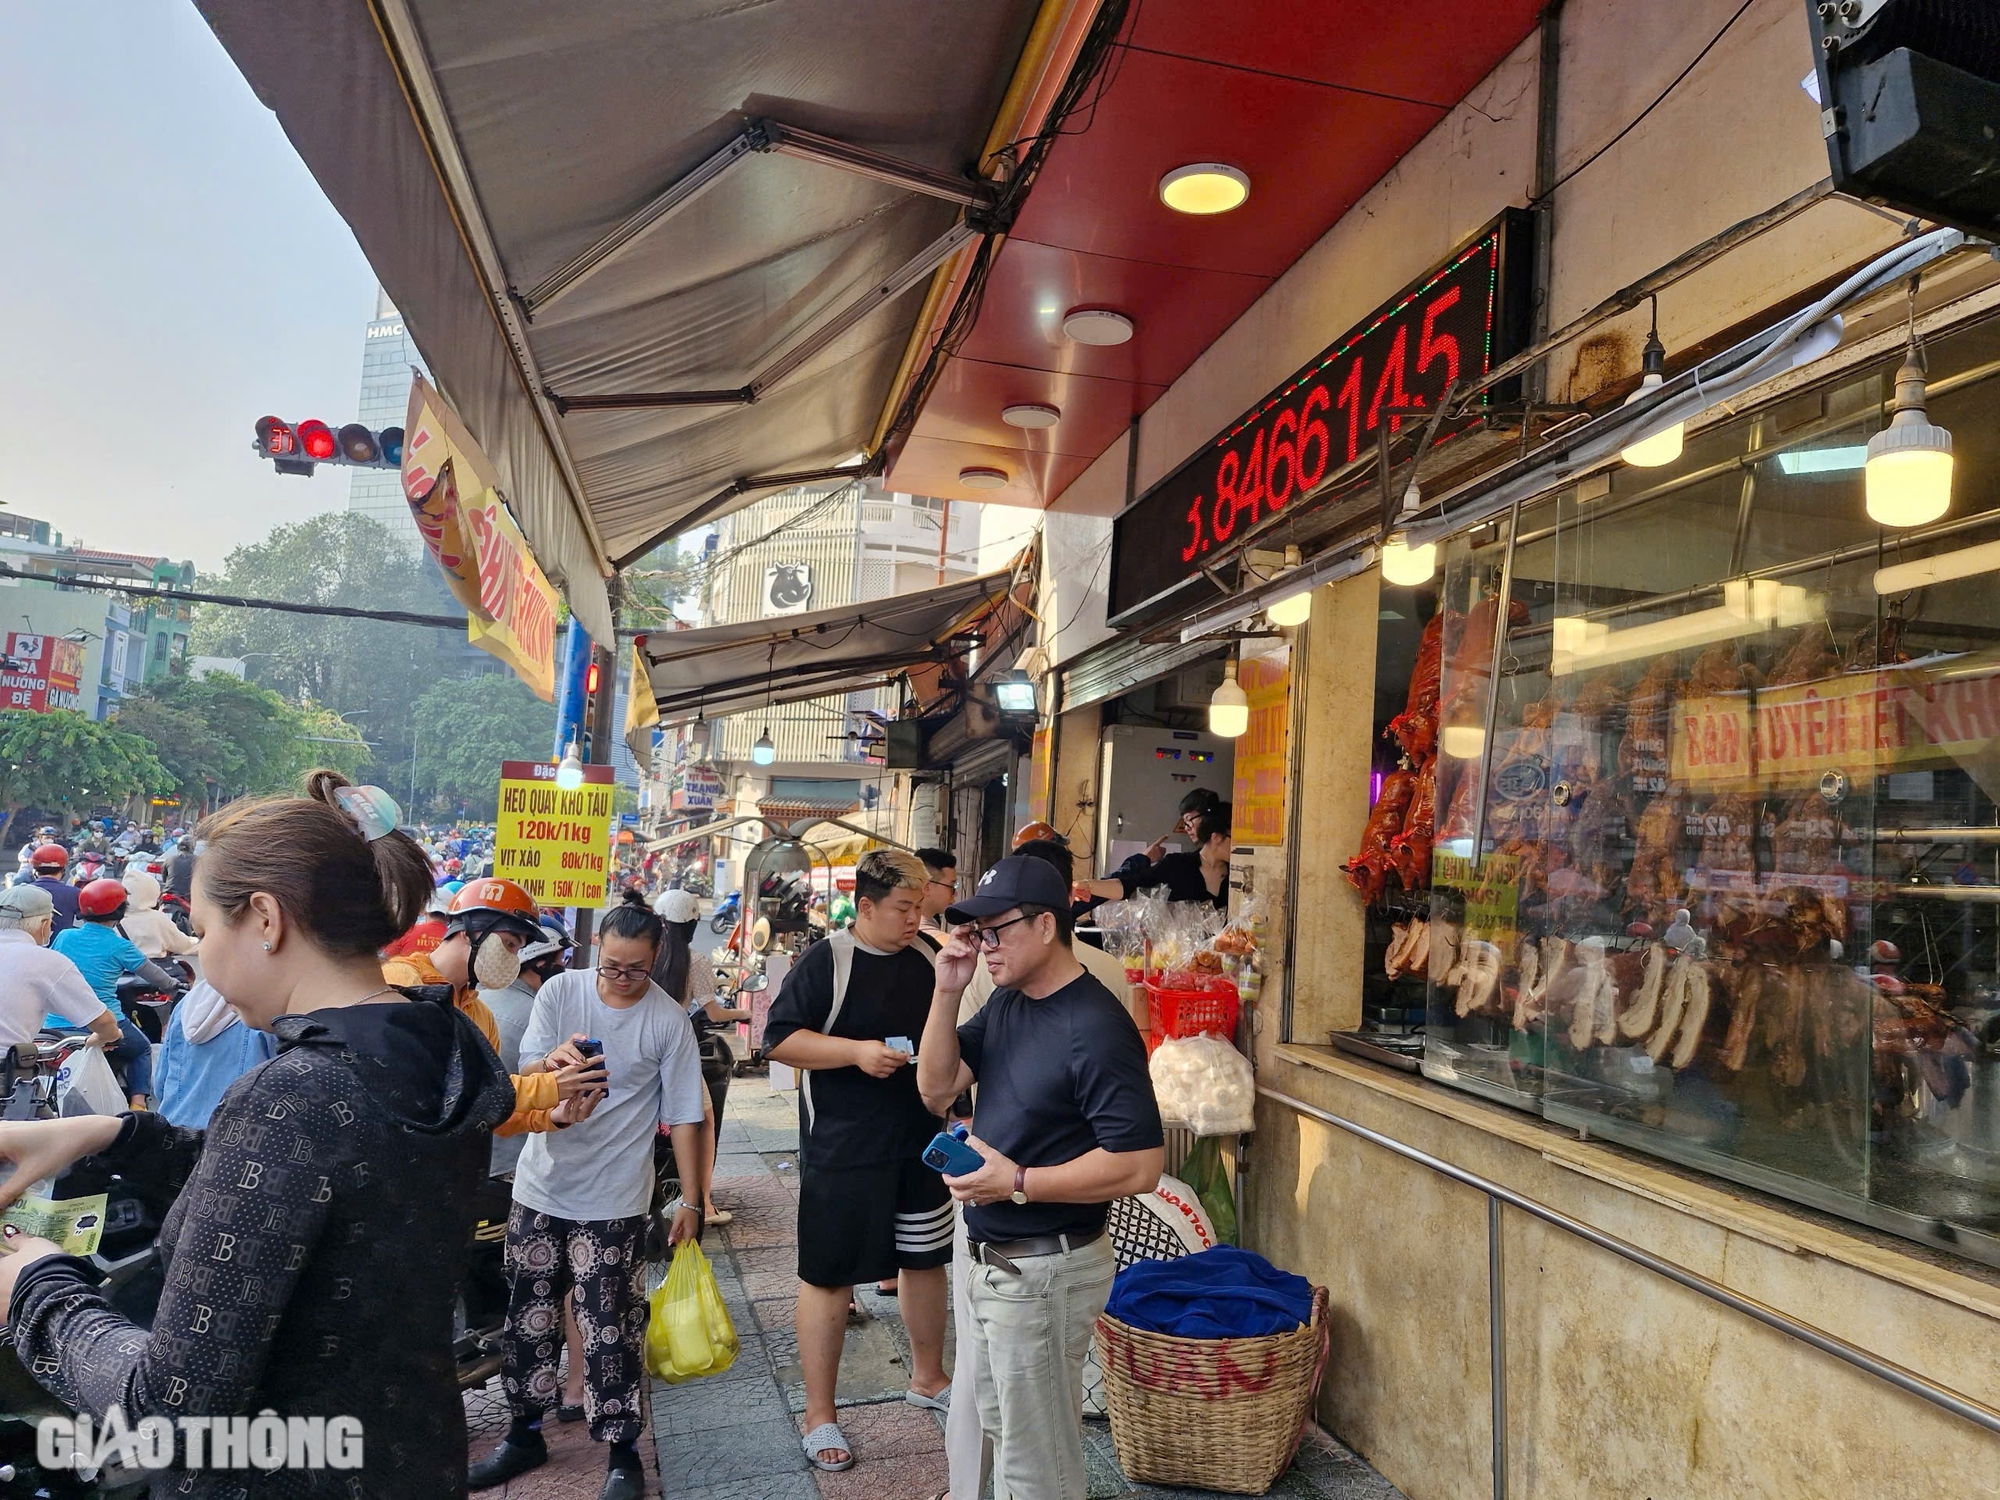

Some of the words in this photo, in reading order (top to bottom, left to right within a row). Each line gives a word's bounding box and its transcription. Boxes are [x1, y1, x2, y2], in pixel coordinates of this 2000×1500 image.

[504, 788, 526, 813] HEO
[530, 790, 558, 817] QUAY
[561, 792, 584, 817] KHO
[588, 788, 608, 818] TÀU
[517, 820, 591, 845] 120k/1kg
[500, 849, 517, 870] VỊT
[519, 846, 541, 868] XÀO
[561, 851, 604, 873] 80k/1kg
[518, 878, 545, 897] ANH
